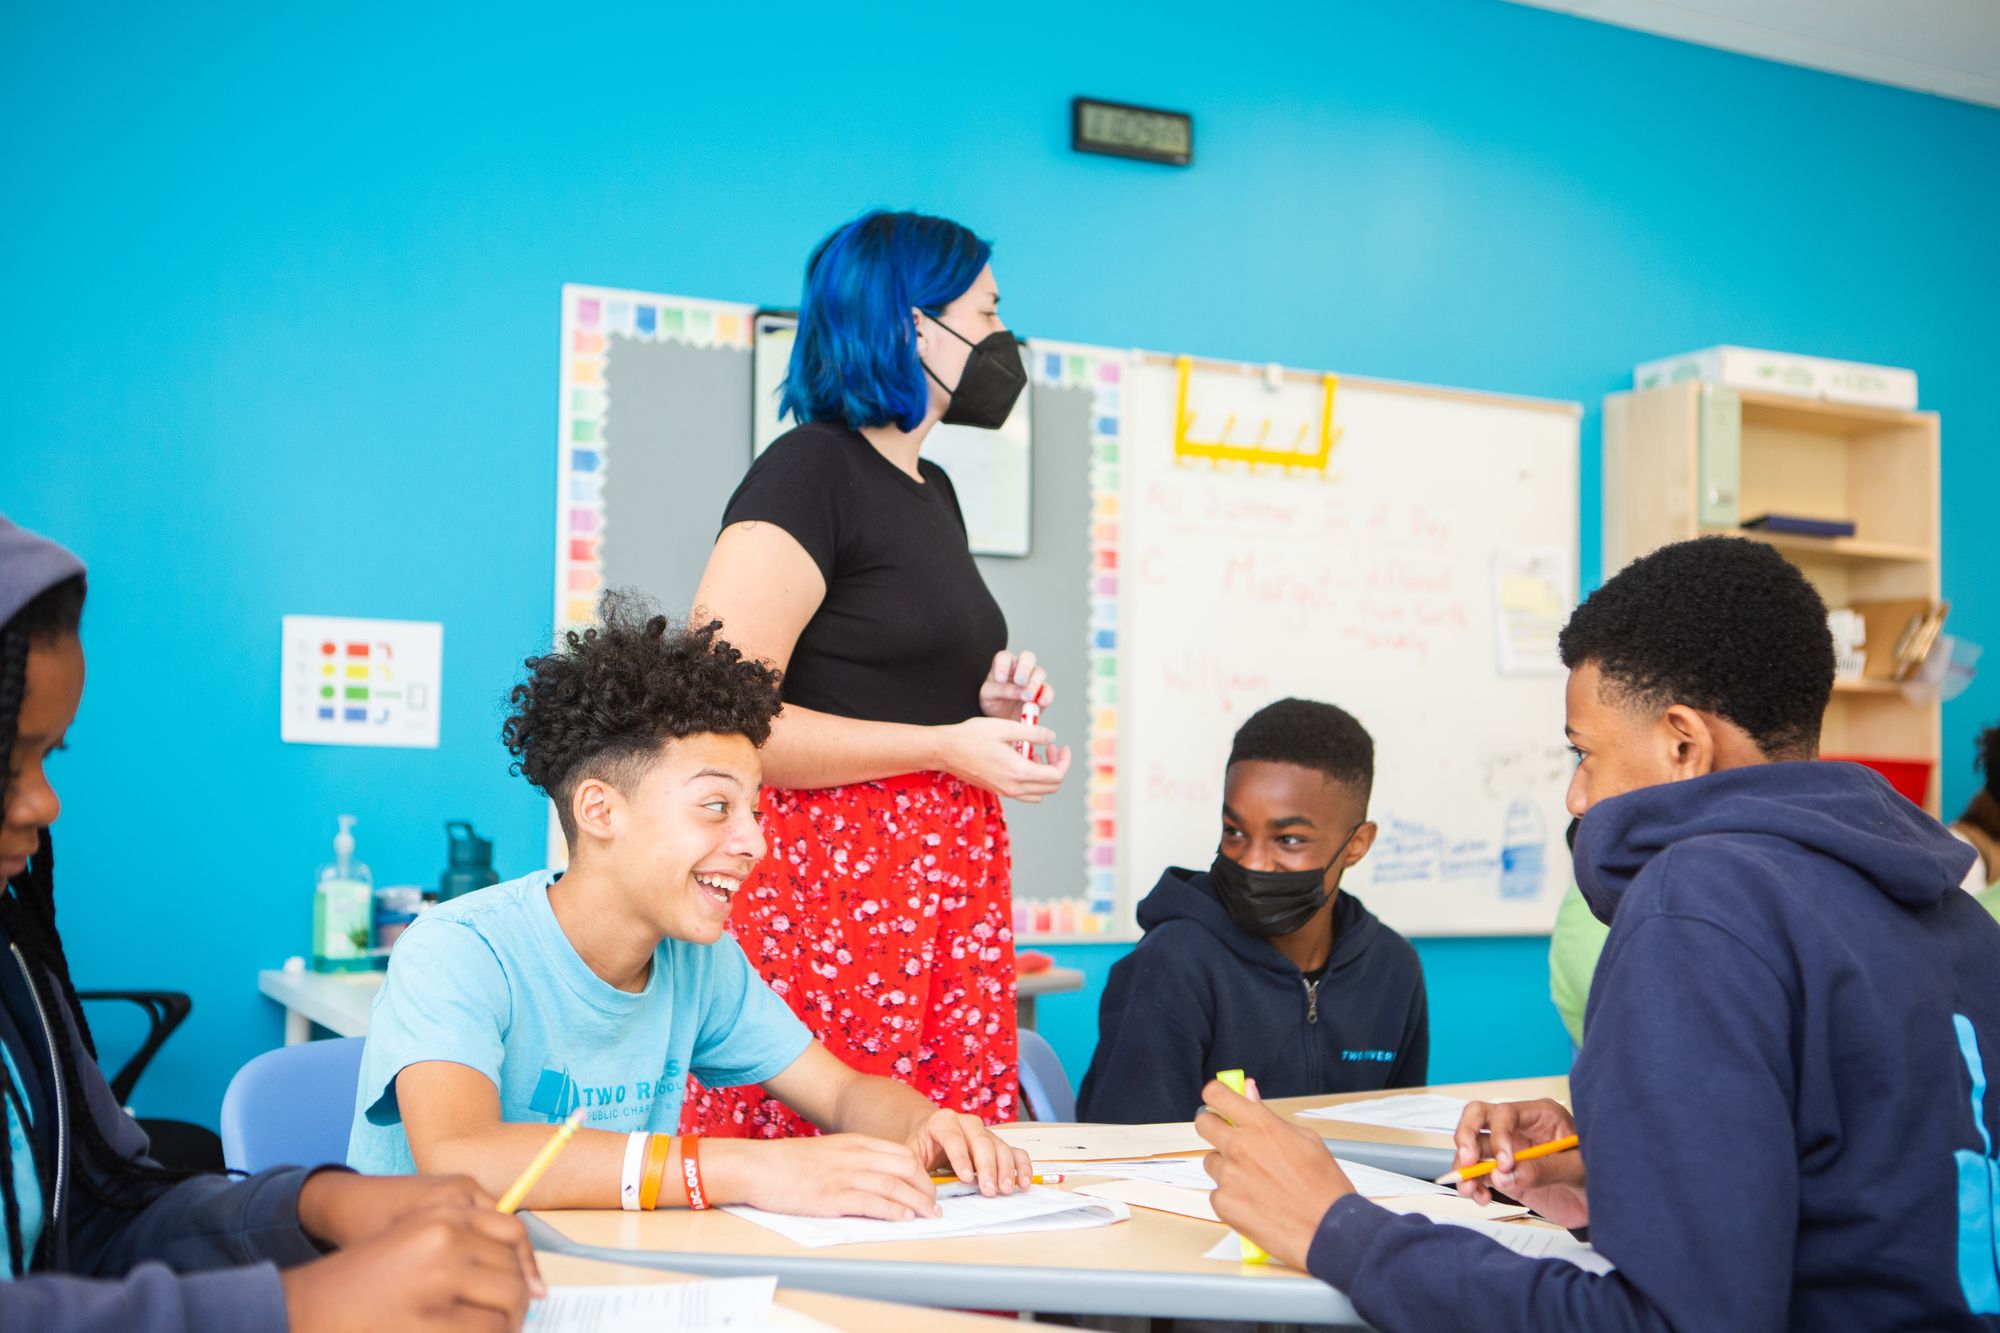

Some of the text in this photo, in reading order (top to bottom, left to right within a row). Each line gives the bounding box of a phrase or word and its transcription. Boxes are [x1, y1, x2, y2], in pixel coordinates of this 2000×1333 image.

[583, 1085, 626, 1106] TWO
[586, 1109, 619, 1121] PUBLIC
[622, 1103, 651, 1117] CHAR
[657, 1081, 682, 1095] OOL
